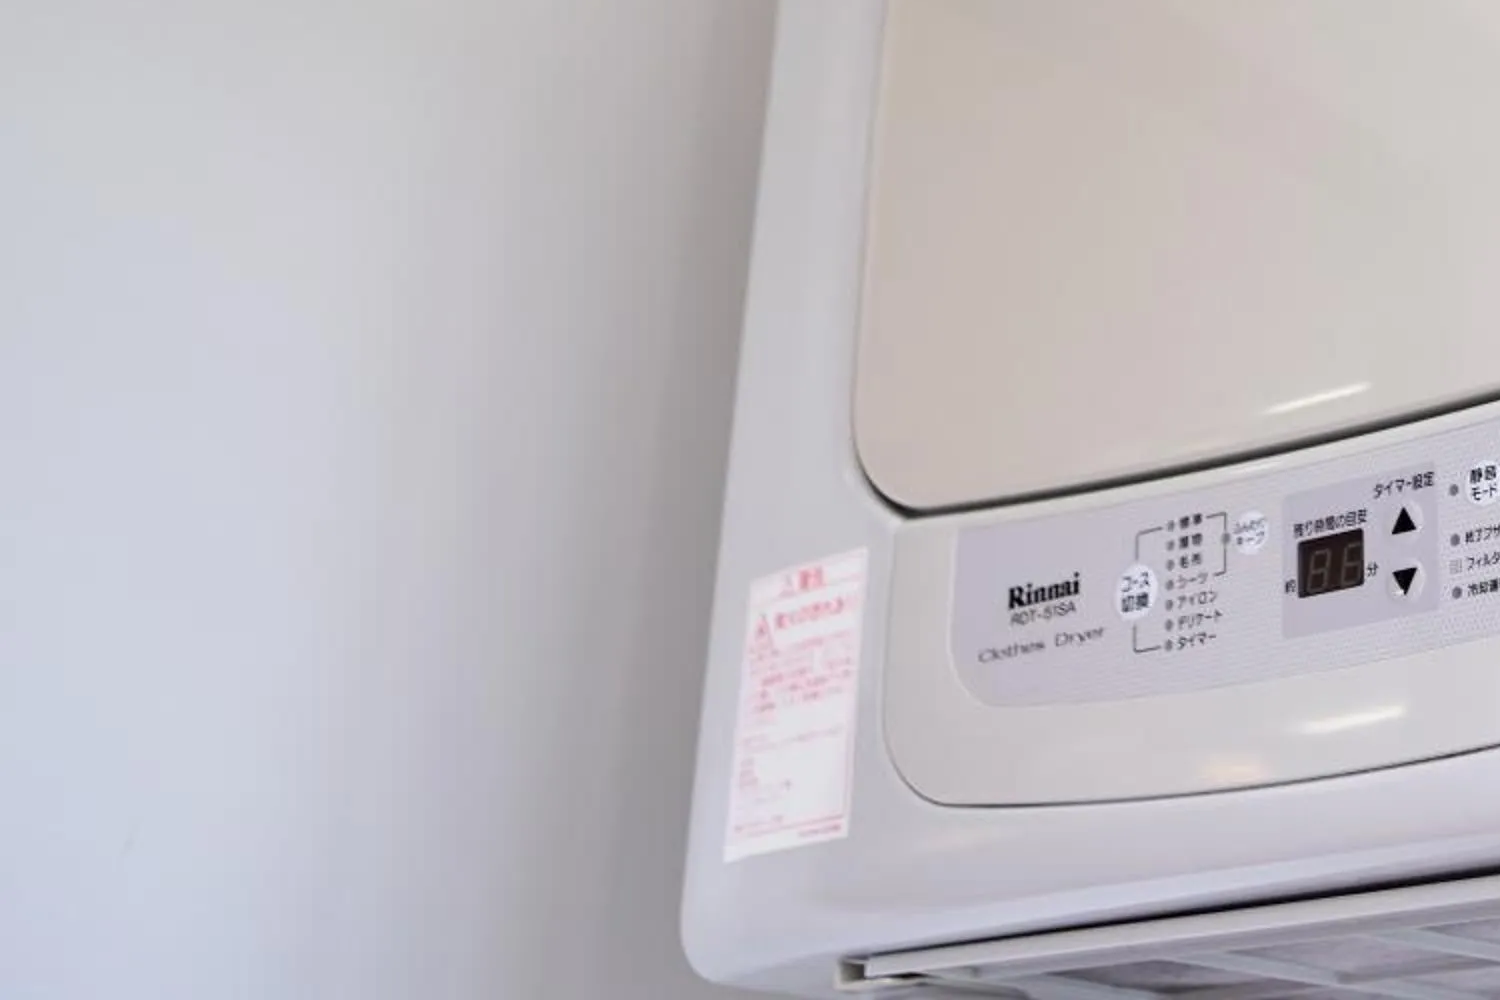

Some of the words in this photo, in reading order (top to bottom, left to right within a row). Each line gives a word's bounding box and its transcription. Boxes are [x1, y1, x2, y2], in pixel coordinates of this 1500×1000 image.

[1373, 471, 1436, 499] タイマー設定
[1471, 484, 1498, 501] モード
[1008, 571, 1081, 610] Rinnai
[1120, 571, 1151, 593] コース
[1176, 591, 1219, 609] アイロン
[978, 640, 1046, 664] Clothes
[1054, 626, 1106, 648] Dryer
[1176, 631, 1217, 651] タイマー
